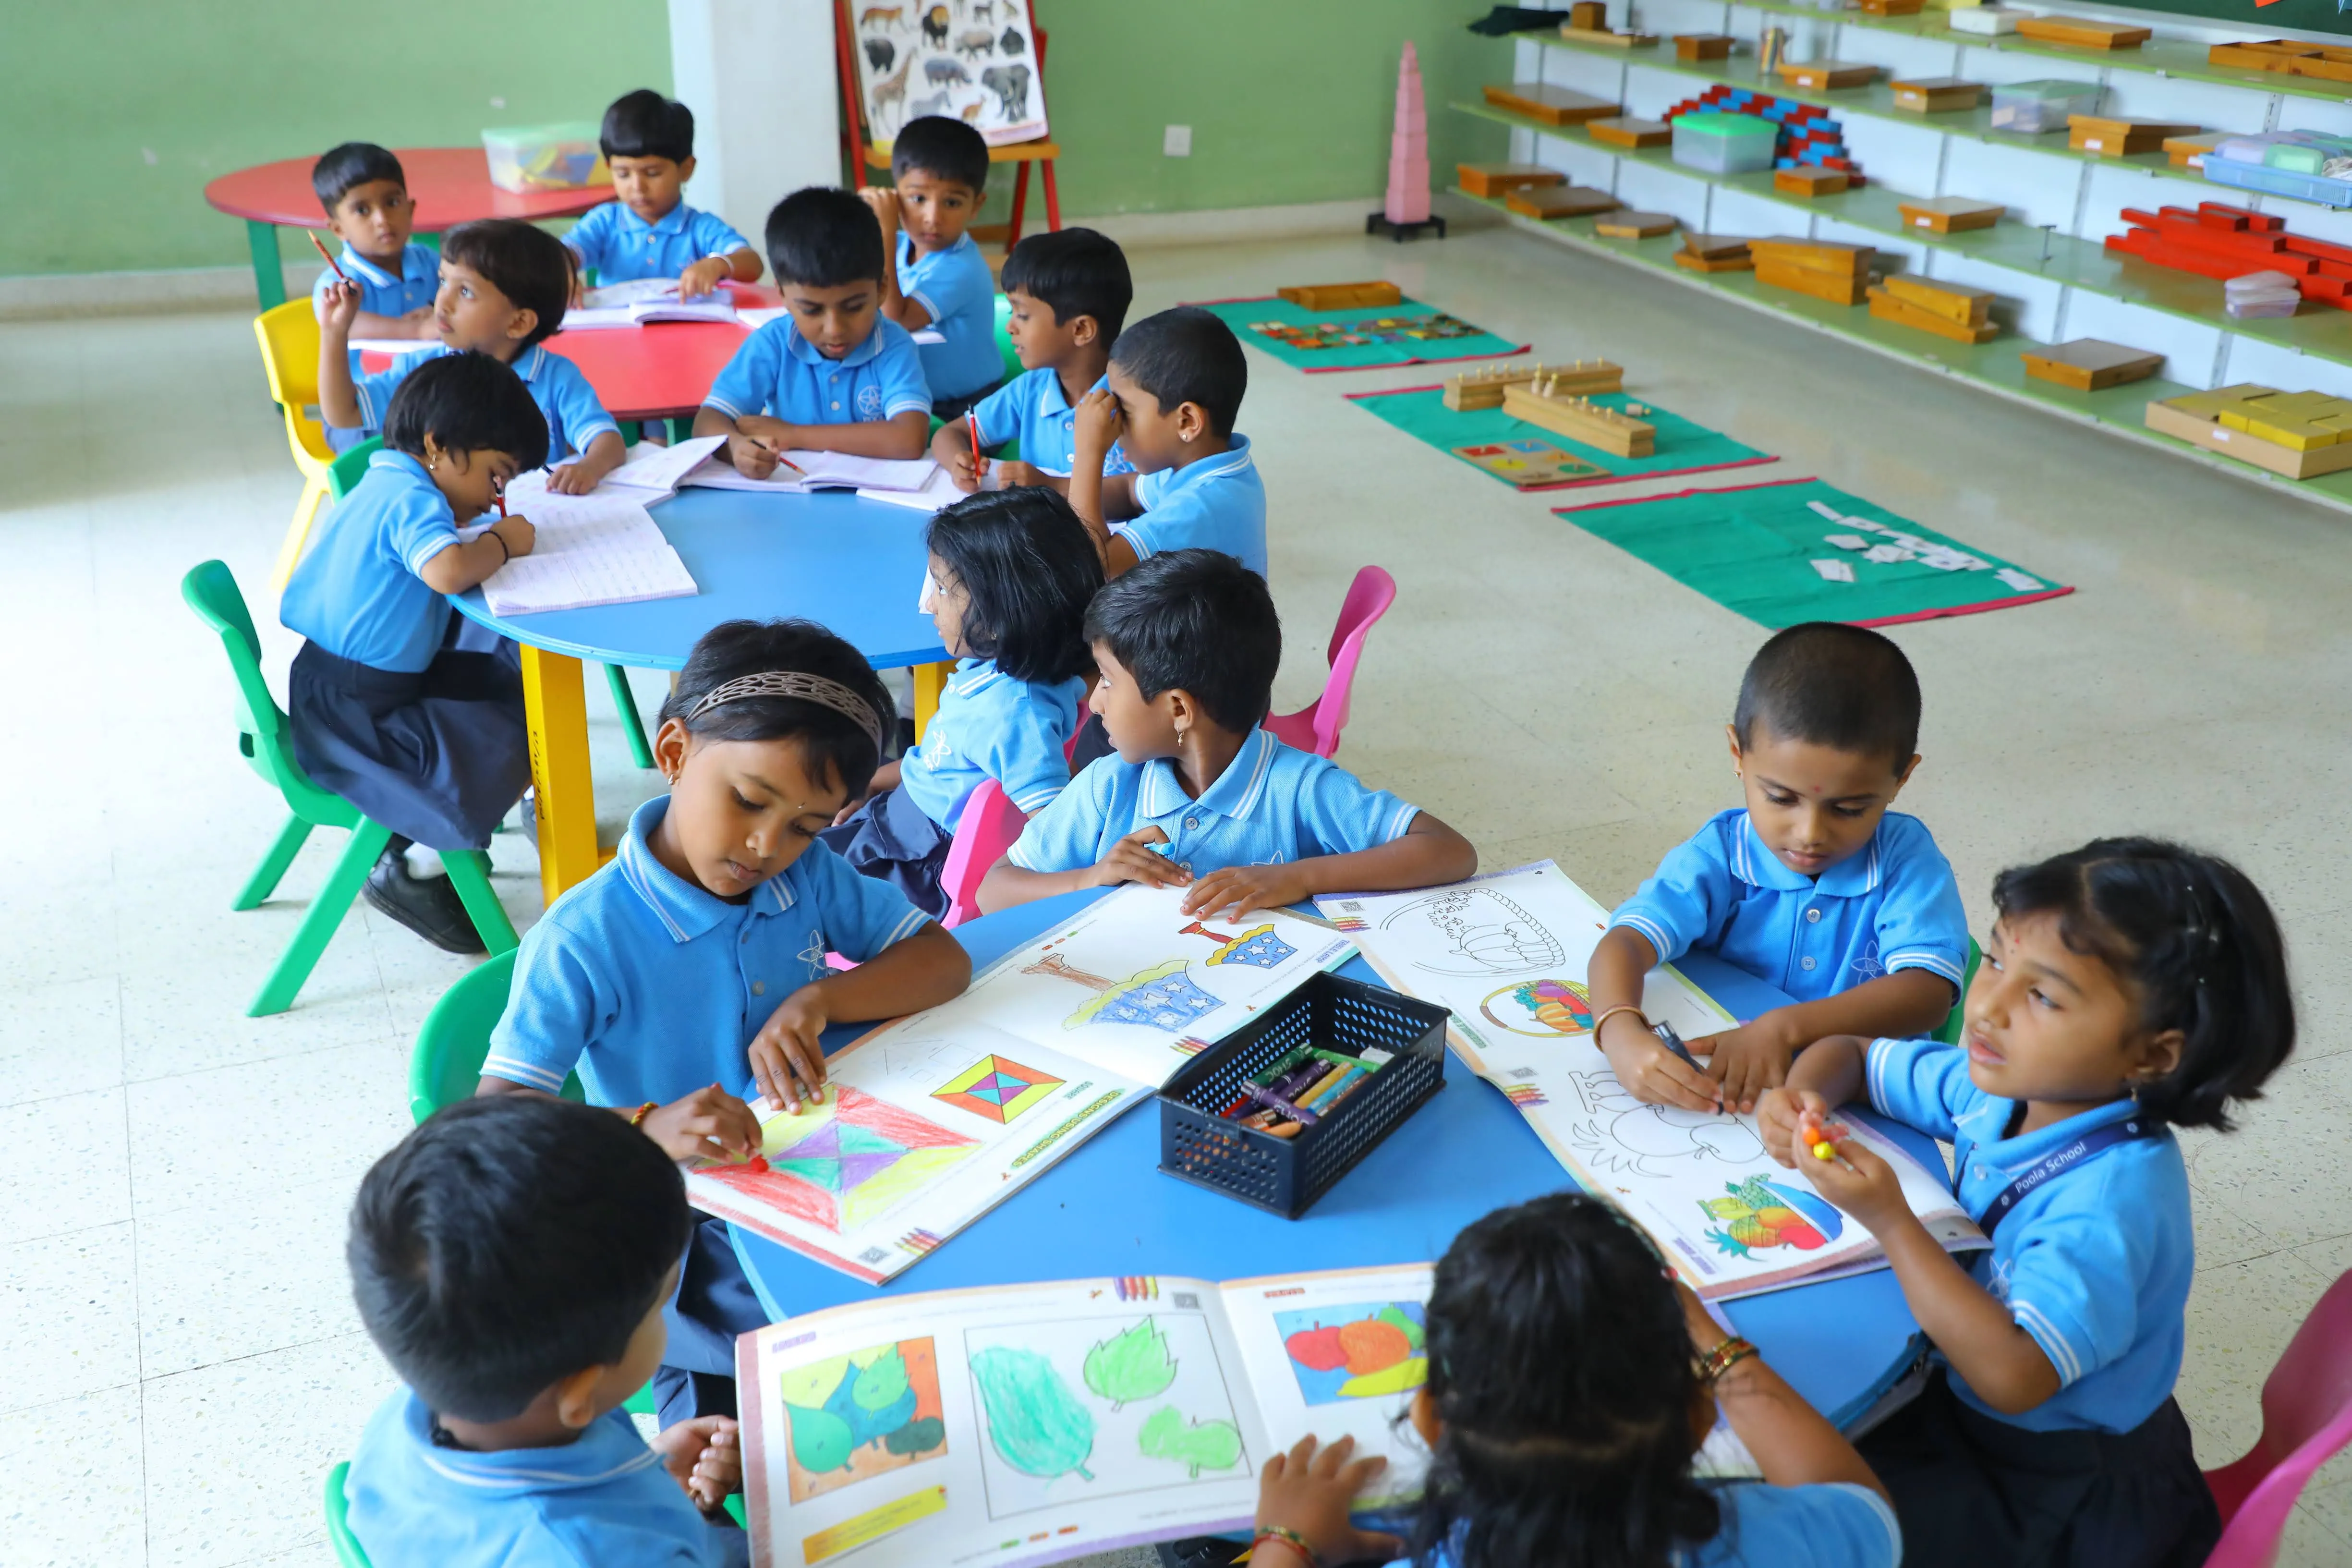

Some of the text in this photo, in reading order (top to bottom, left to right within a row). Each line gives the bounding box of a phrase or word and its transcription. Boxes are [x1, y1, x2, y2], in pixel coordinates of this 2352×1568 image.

[1316, 940, 1350, 962] TABLE LAMP
[1063, 1081, 1093, 1100] SQUARE
[1078, 1091, 1121, 1120] DESIGNS
[1049, 1118, 1081, 1140] USING
[1012, 1139, 1053, 1167] SHAPES
[2015, 1141, 2086, 1193] Poola School
